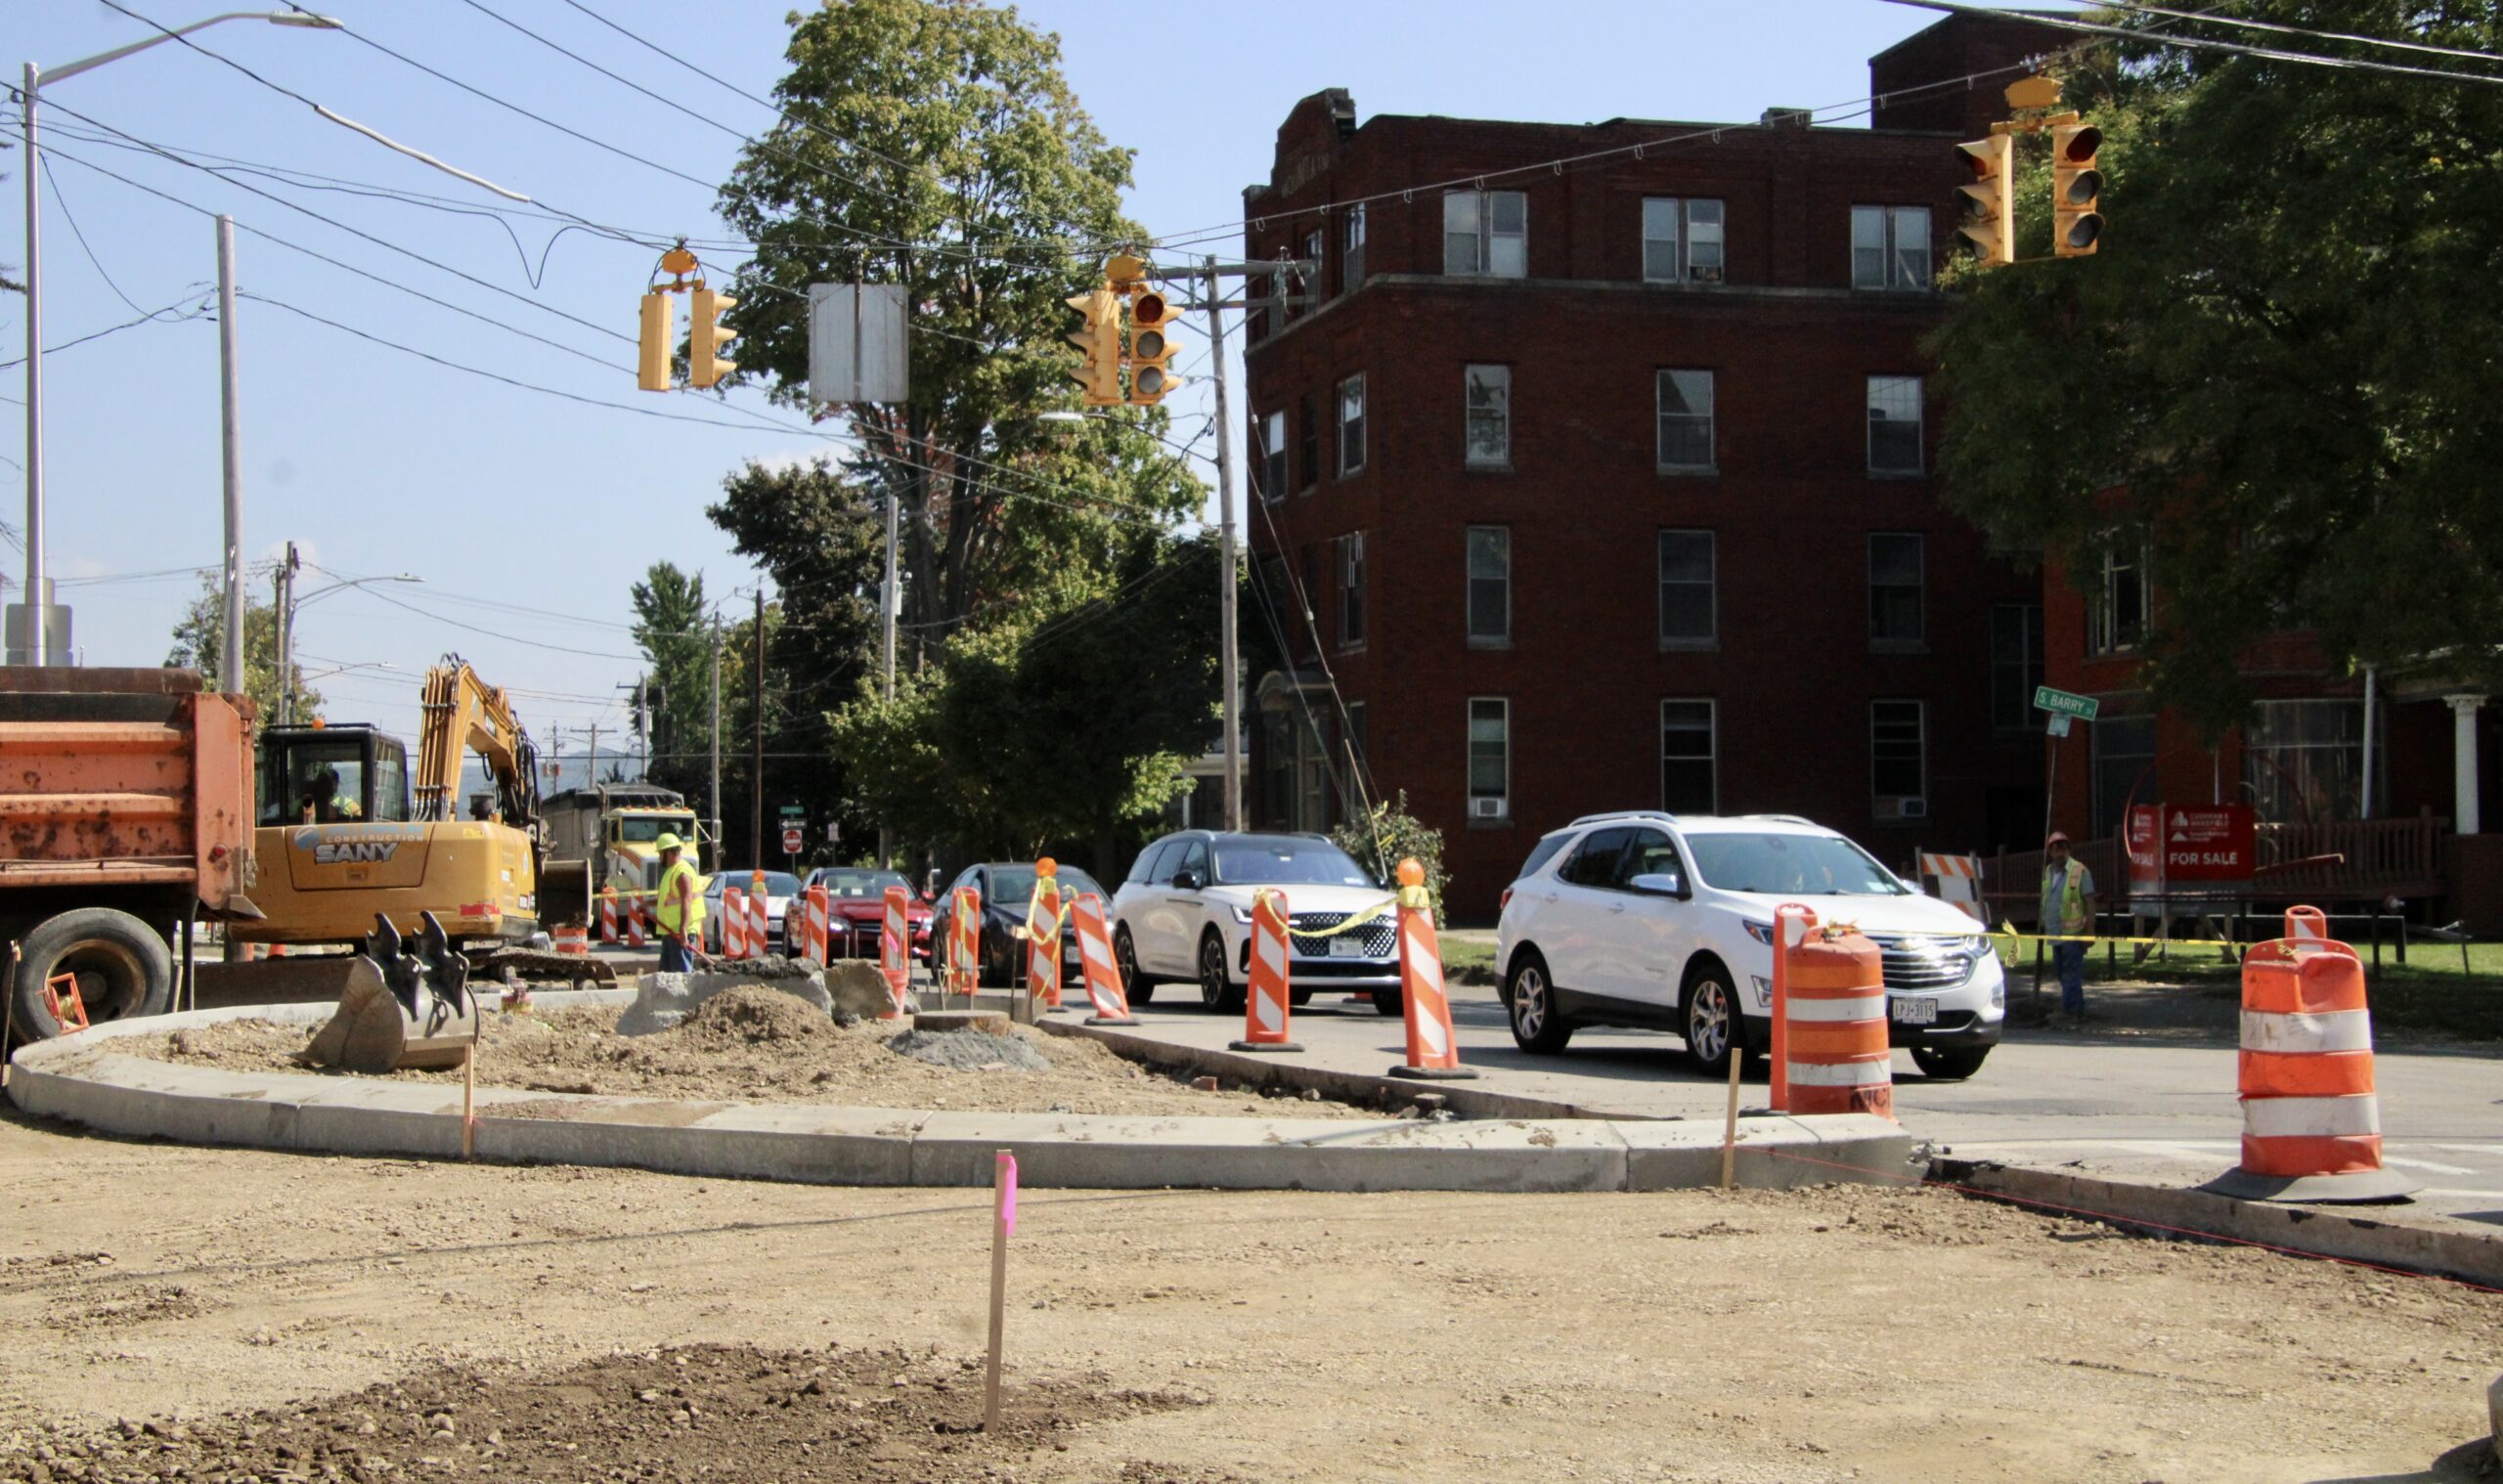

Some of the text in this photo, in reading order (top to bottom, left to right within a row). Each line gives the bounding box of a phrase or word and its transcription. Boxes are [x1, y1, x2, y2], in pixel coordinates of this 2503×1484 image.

[2050, 694, 2086, 714] BARRY
[326, 834, 424, 844] CONSTRUCTION
[314, 841, 401, 865] SANY
[2170, 851, 2238, 865] FOR SALE
